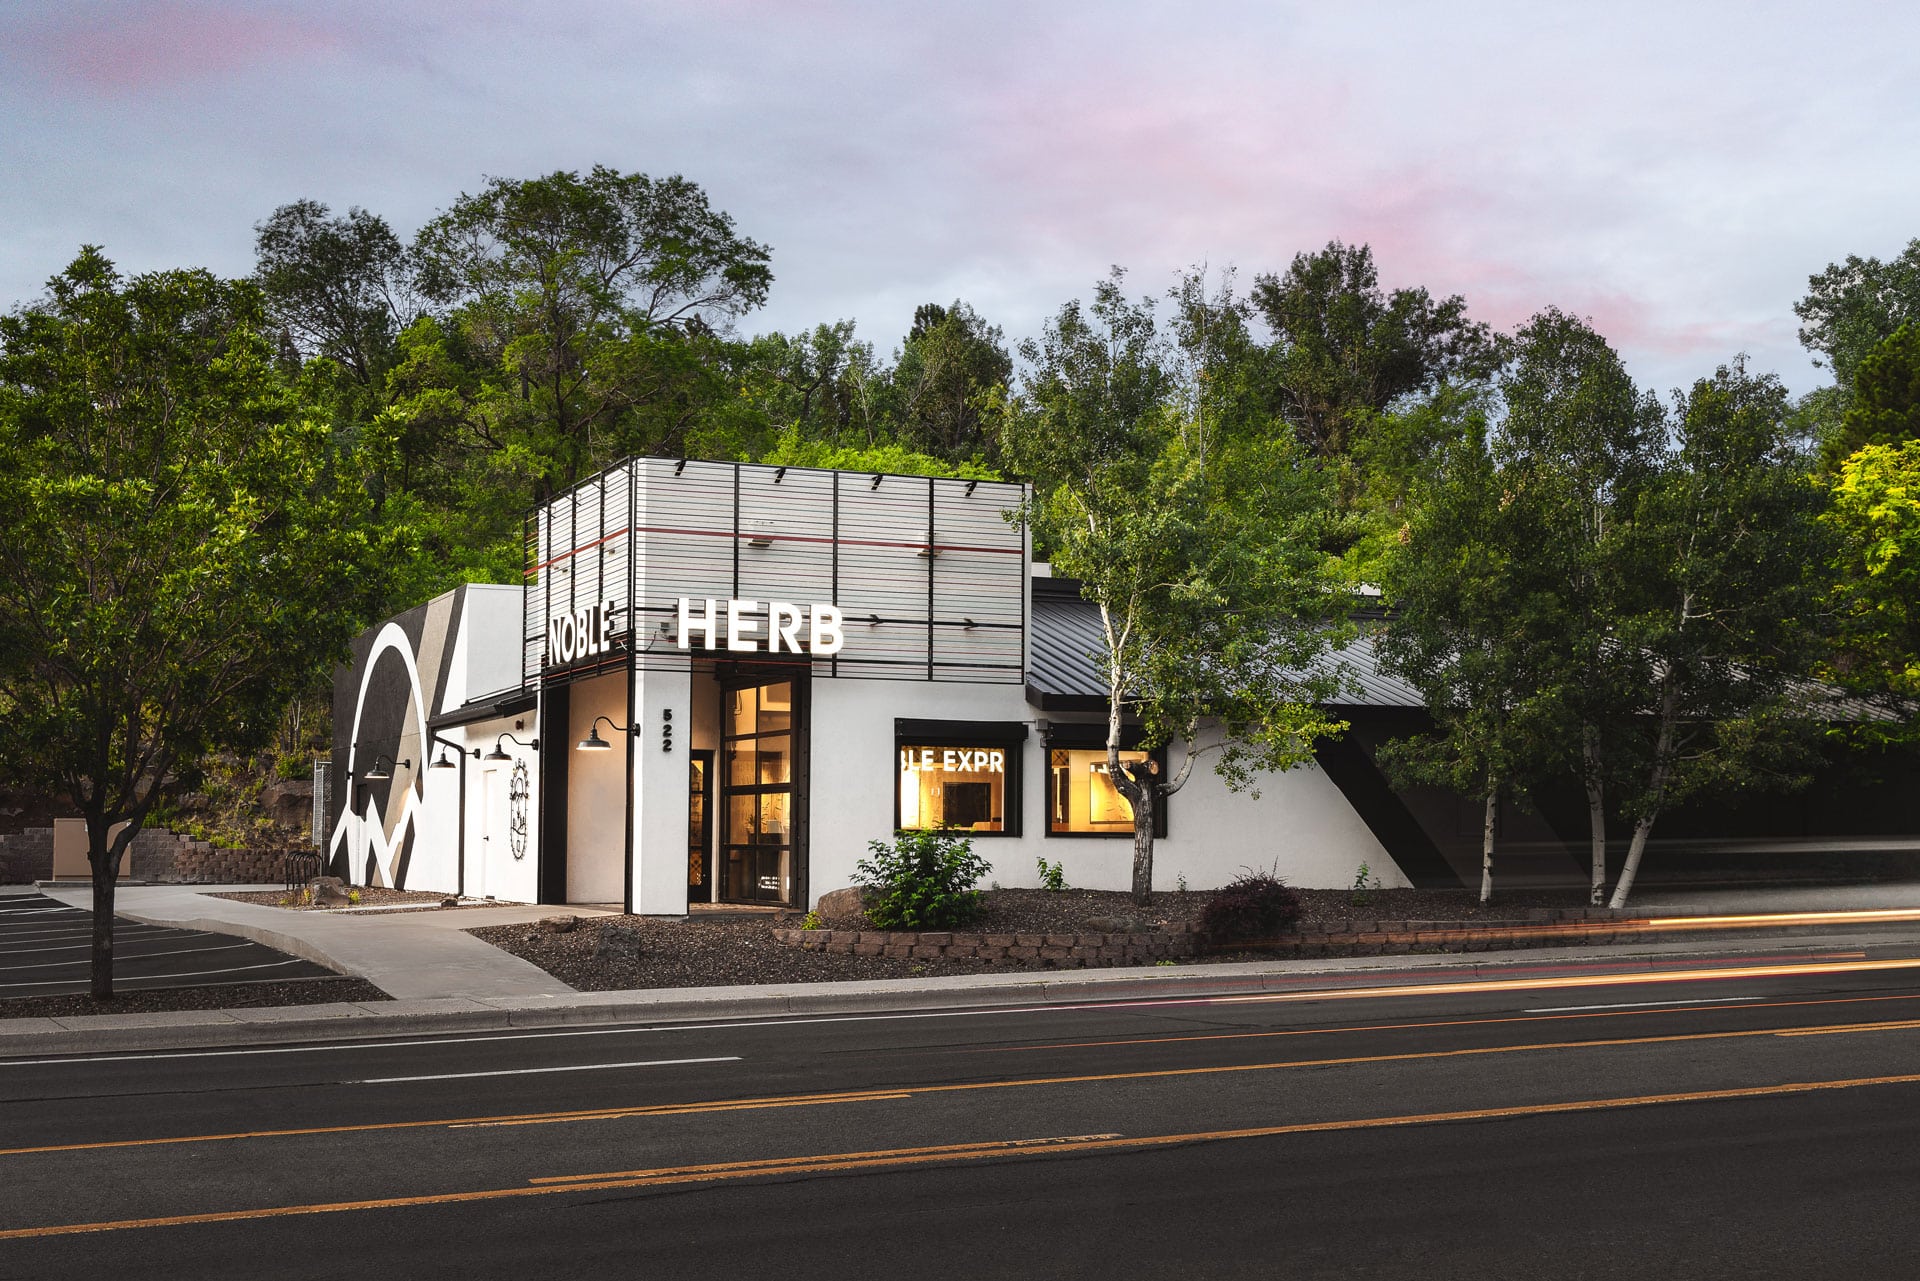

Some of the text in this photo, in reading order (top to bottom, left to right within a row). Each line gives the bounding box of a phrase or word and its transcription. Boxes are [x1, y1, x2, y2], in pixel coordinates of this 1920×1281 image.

[549, 597, 845, 666] NOBLE HERB
[662, 708, 673, 753] 522
[943, 750, 1004, 773] EXPR
